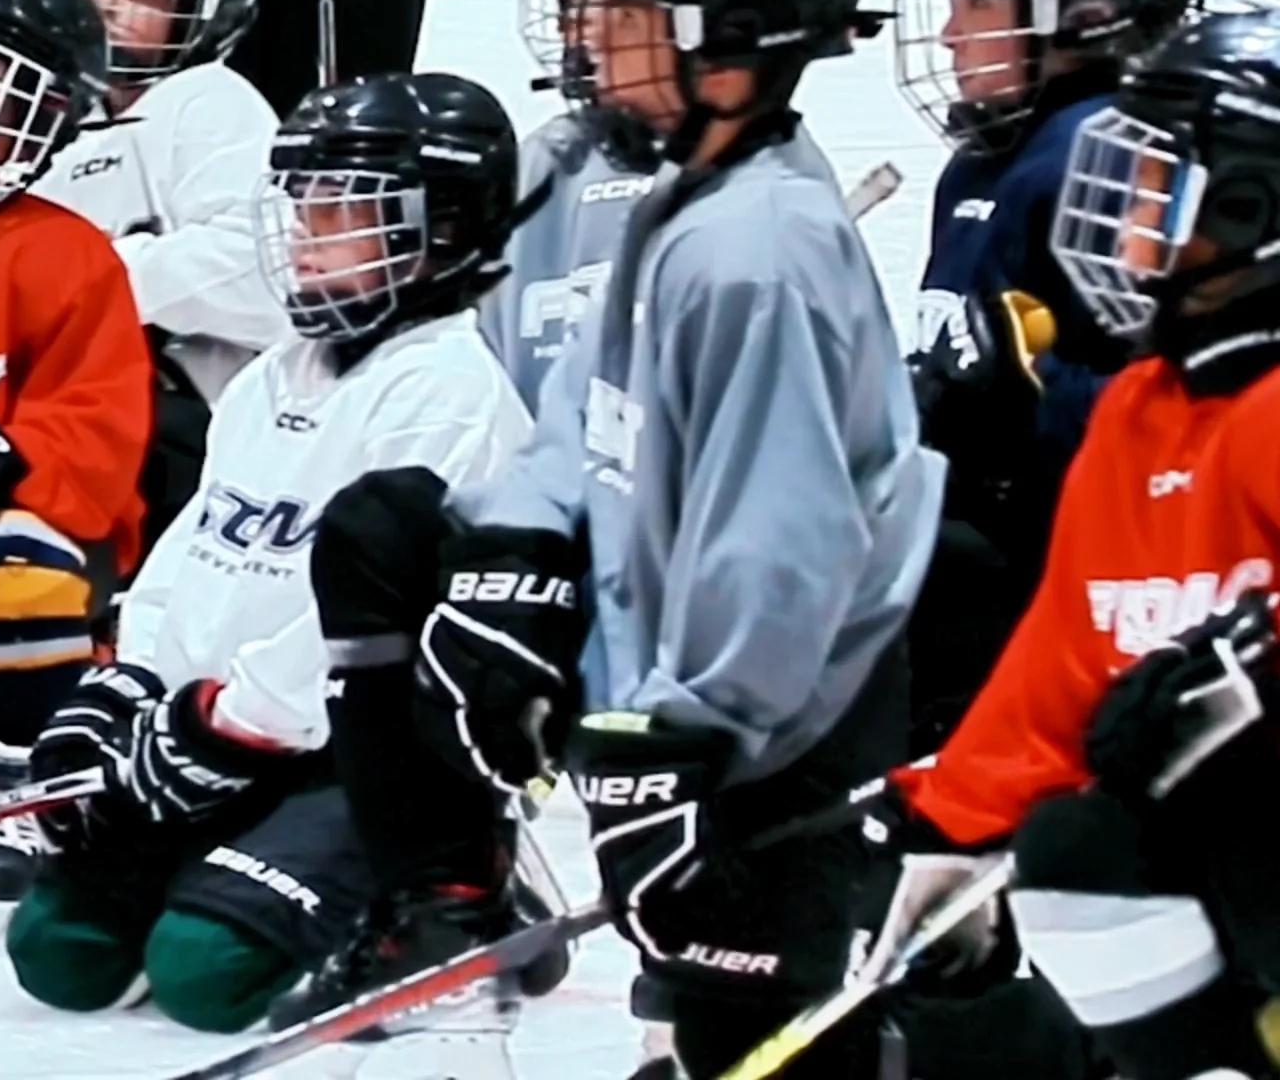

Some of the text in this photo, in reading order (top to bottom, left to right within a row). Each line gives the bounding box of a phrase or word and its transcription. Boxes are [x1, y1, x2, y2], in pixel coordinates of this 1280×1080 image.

[69, 156, 123, 182] CCM
[582, 175, 656, 203] CCM
[203, 845, 322, 917] BAUER
